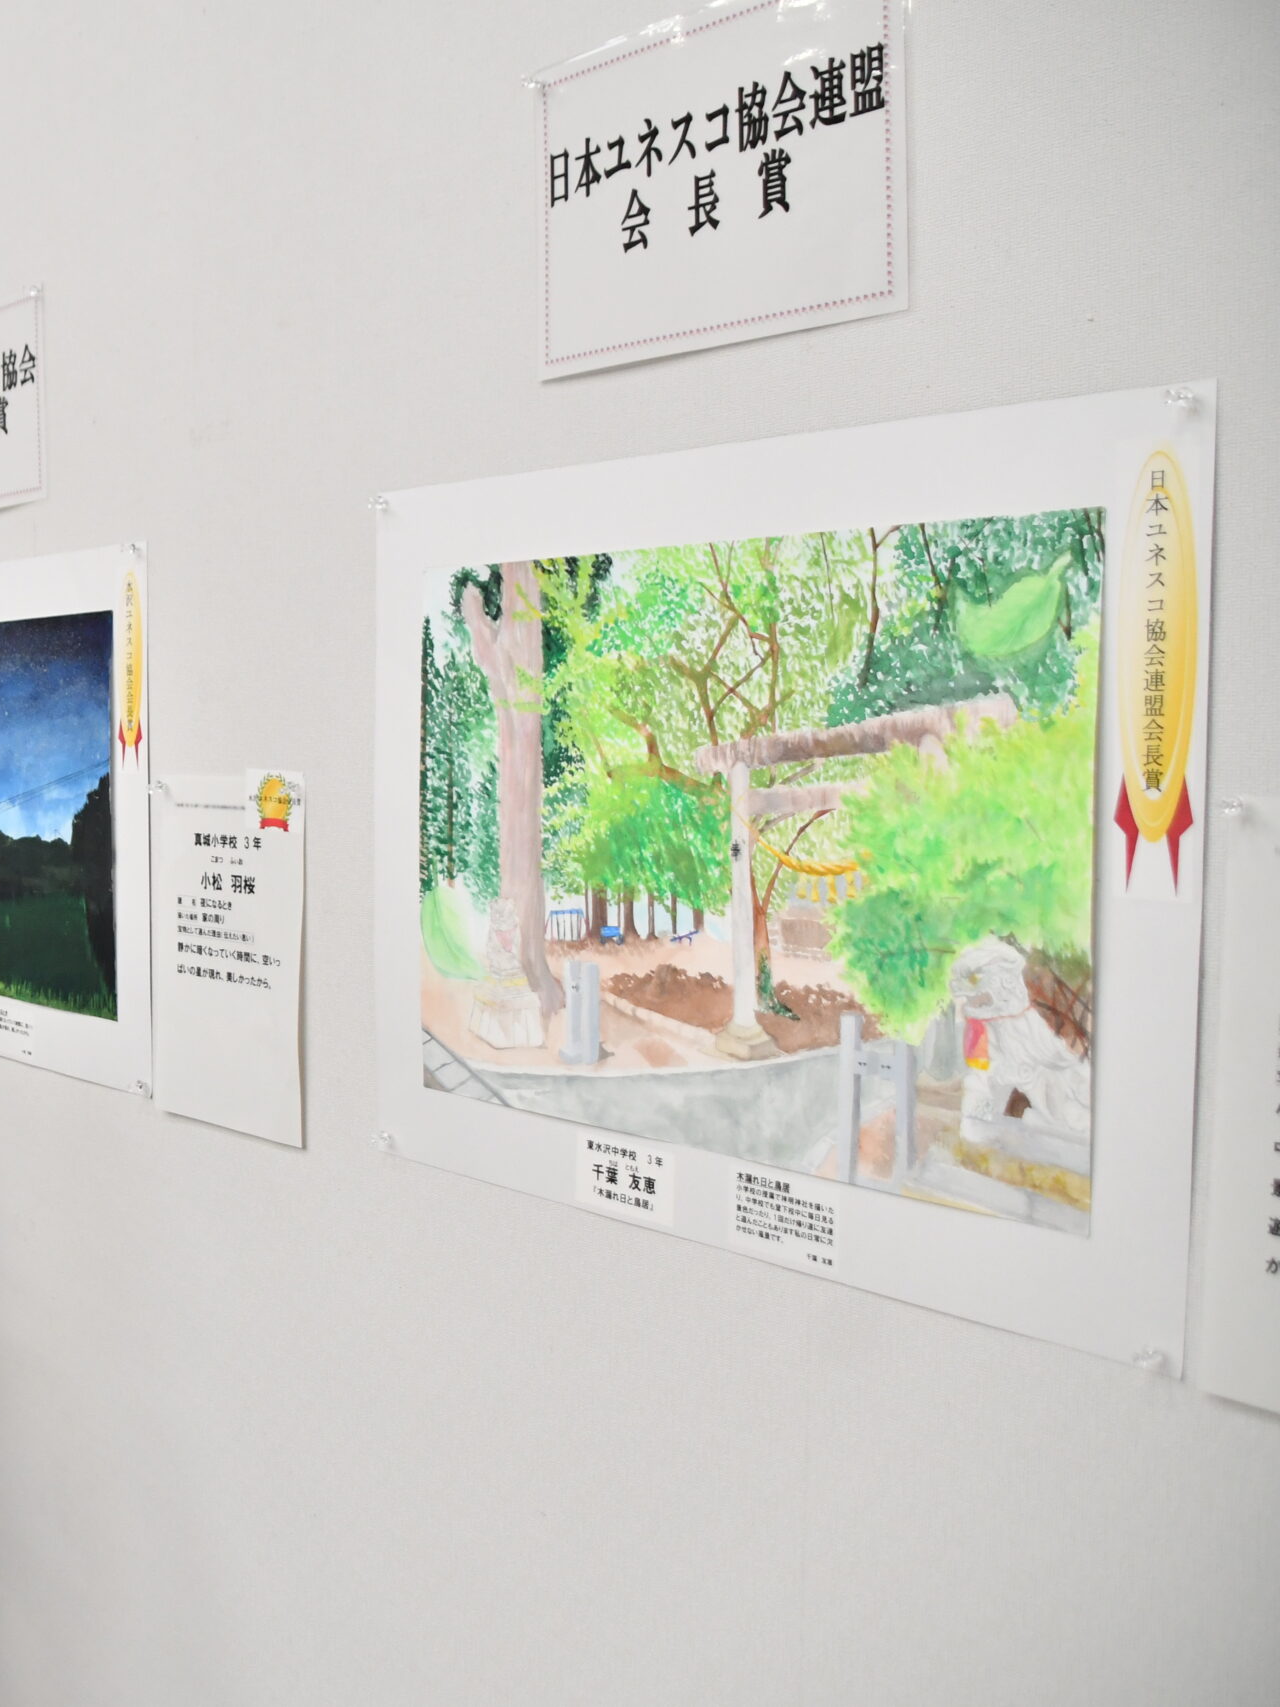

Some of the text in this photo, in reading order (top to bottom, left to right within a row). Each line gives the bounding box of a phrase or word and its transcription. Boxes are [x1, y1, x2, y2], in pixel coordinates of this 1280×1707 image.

[549, 42, 885, 208] 日本ユネスコ協会連盟
[621, 147, 792, 254] 会長賞
[1141, 469, 1168, 794] 日本ユネスコ協会連盟会長賞
[194, 833, 237, 849] 真城小学校
[201, 871, 256, 895] 小松 羽桜
[587, 1140, 637, 1162] 東水沢中学校
[592, 1163, 656, 1195] 千葉 友恵
